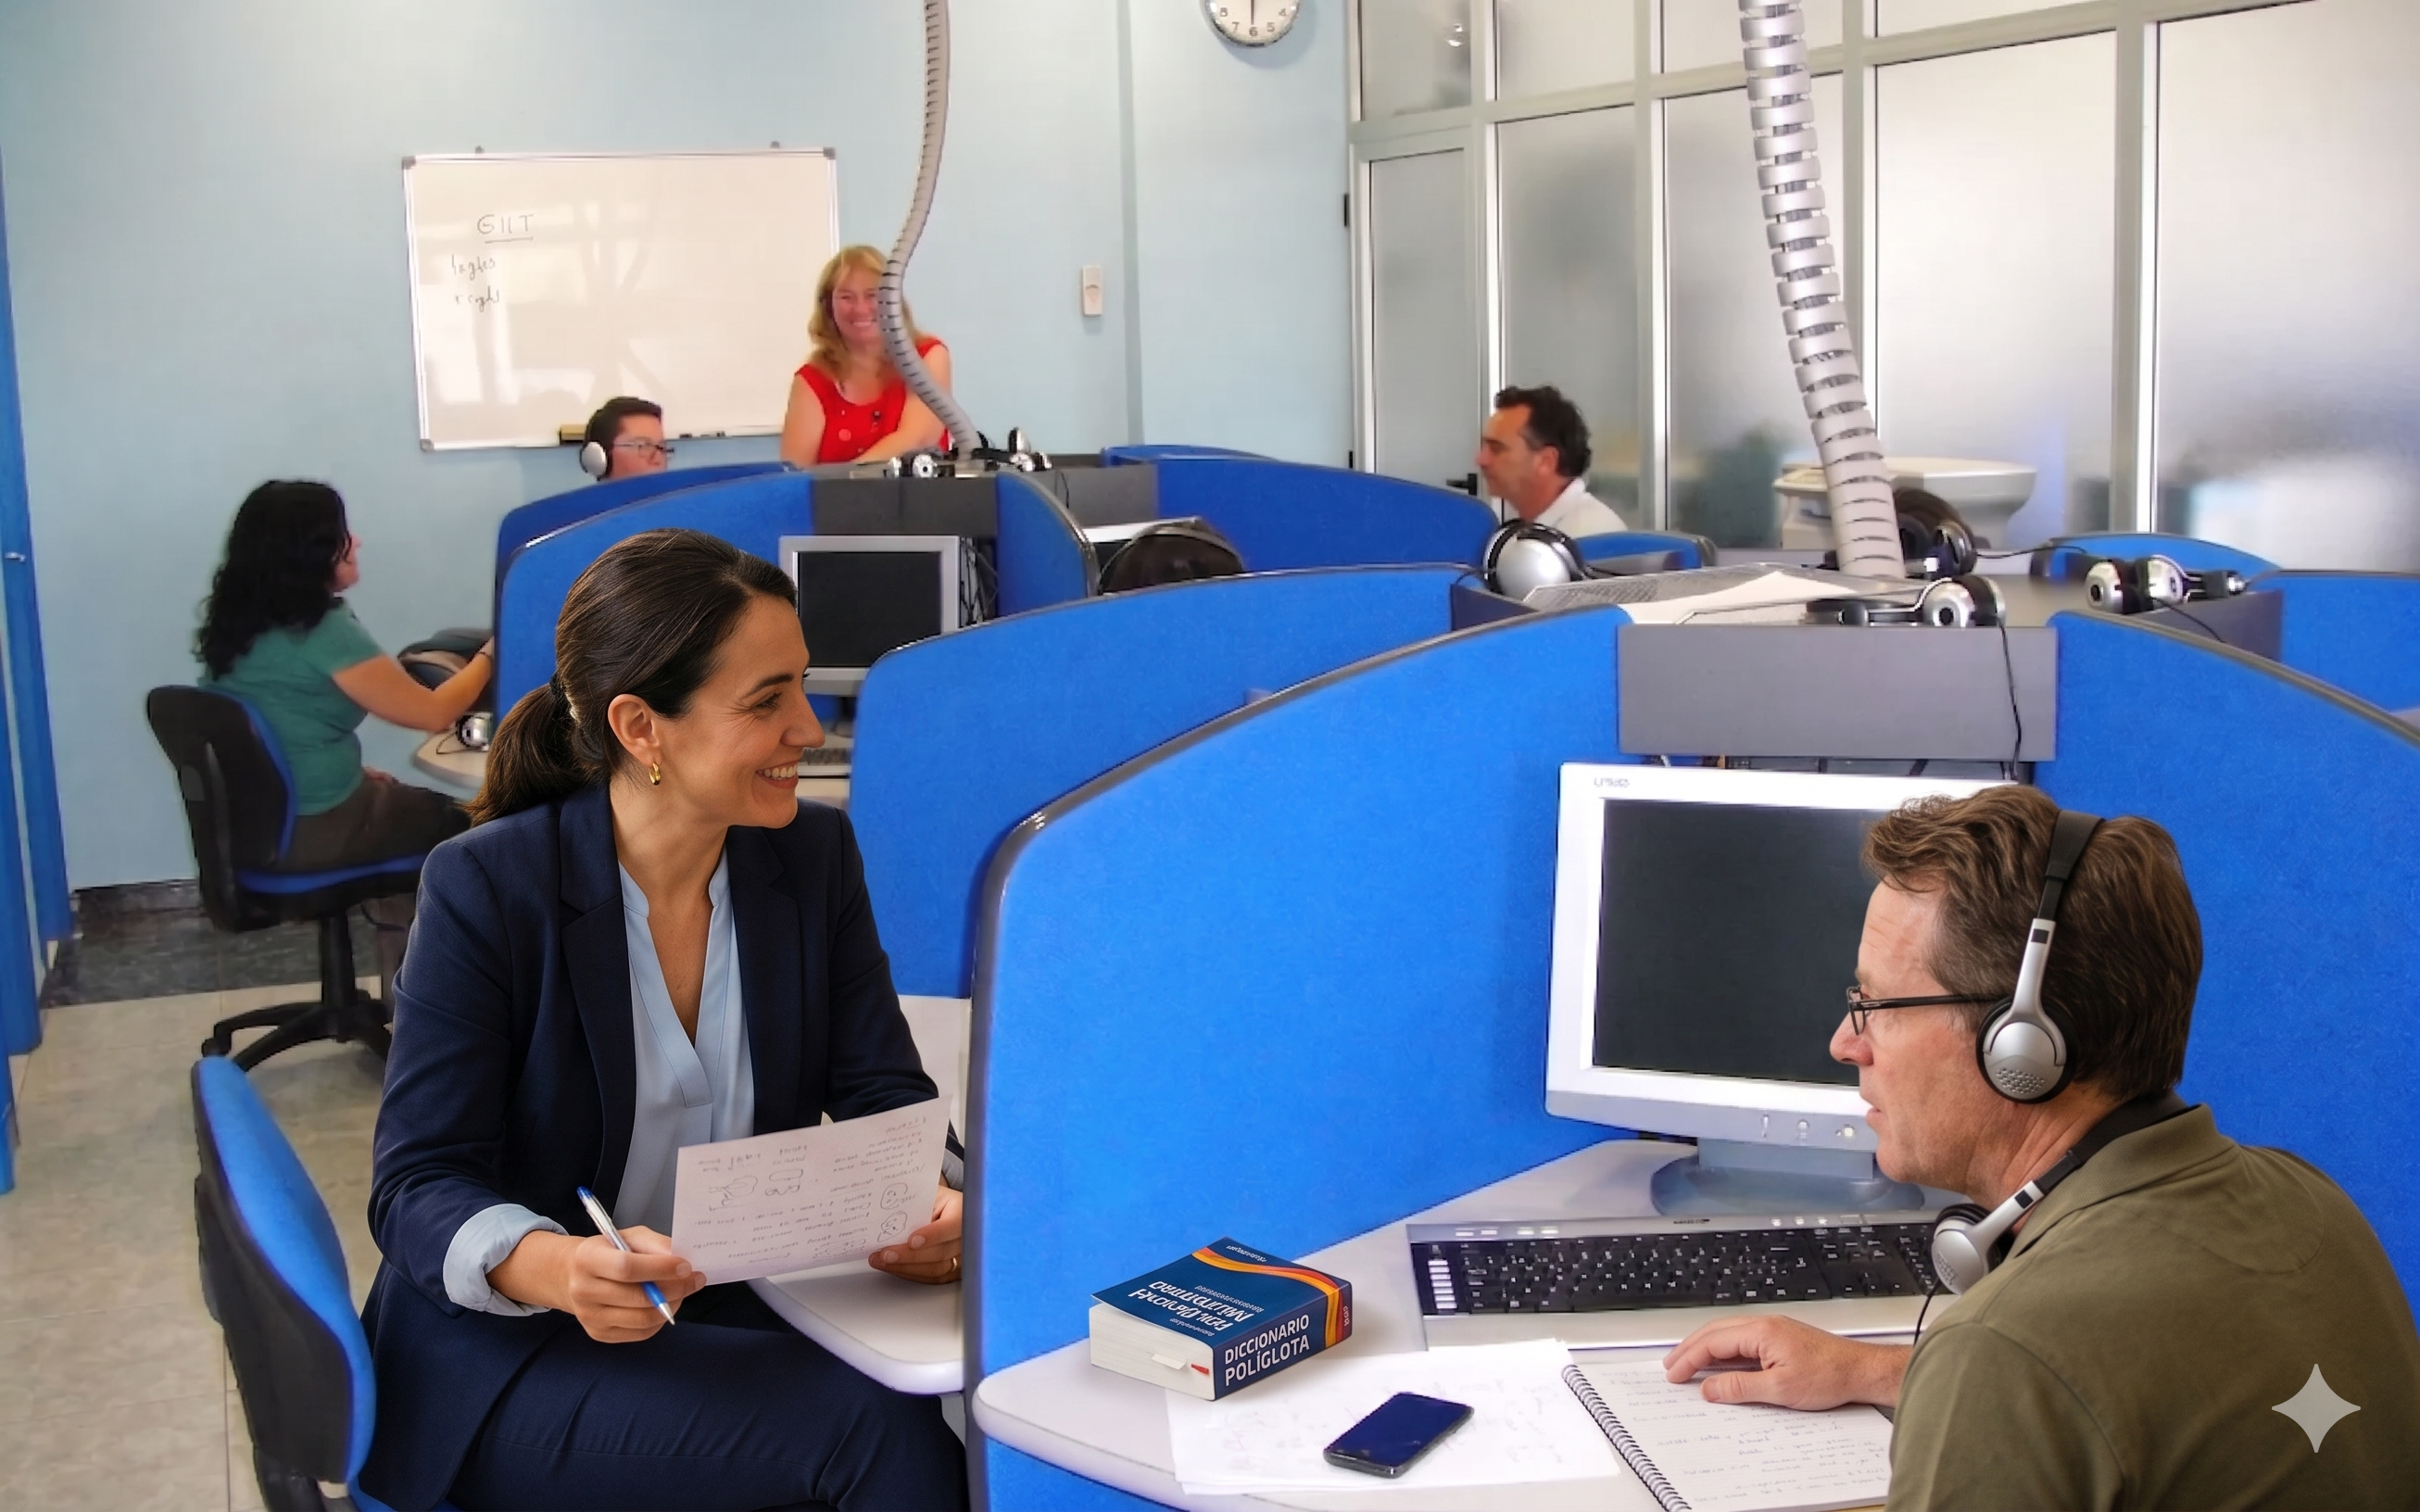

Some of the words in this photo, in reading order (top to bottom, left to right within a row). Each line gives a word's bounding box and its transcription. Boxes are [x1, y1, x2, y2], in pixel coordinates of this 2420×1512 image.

[1231, 21, 1240, 33] 7
[1249, 26, 1258, 37] 6
[1267, 21, 1276, 32] 5
[1224, 1314, 1310, 1366] DICCIONARIO
[1224, 1334, 1310, 1387] POLÍGLOTA
